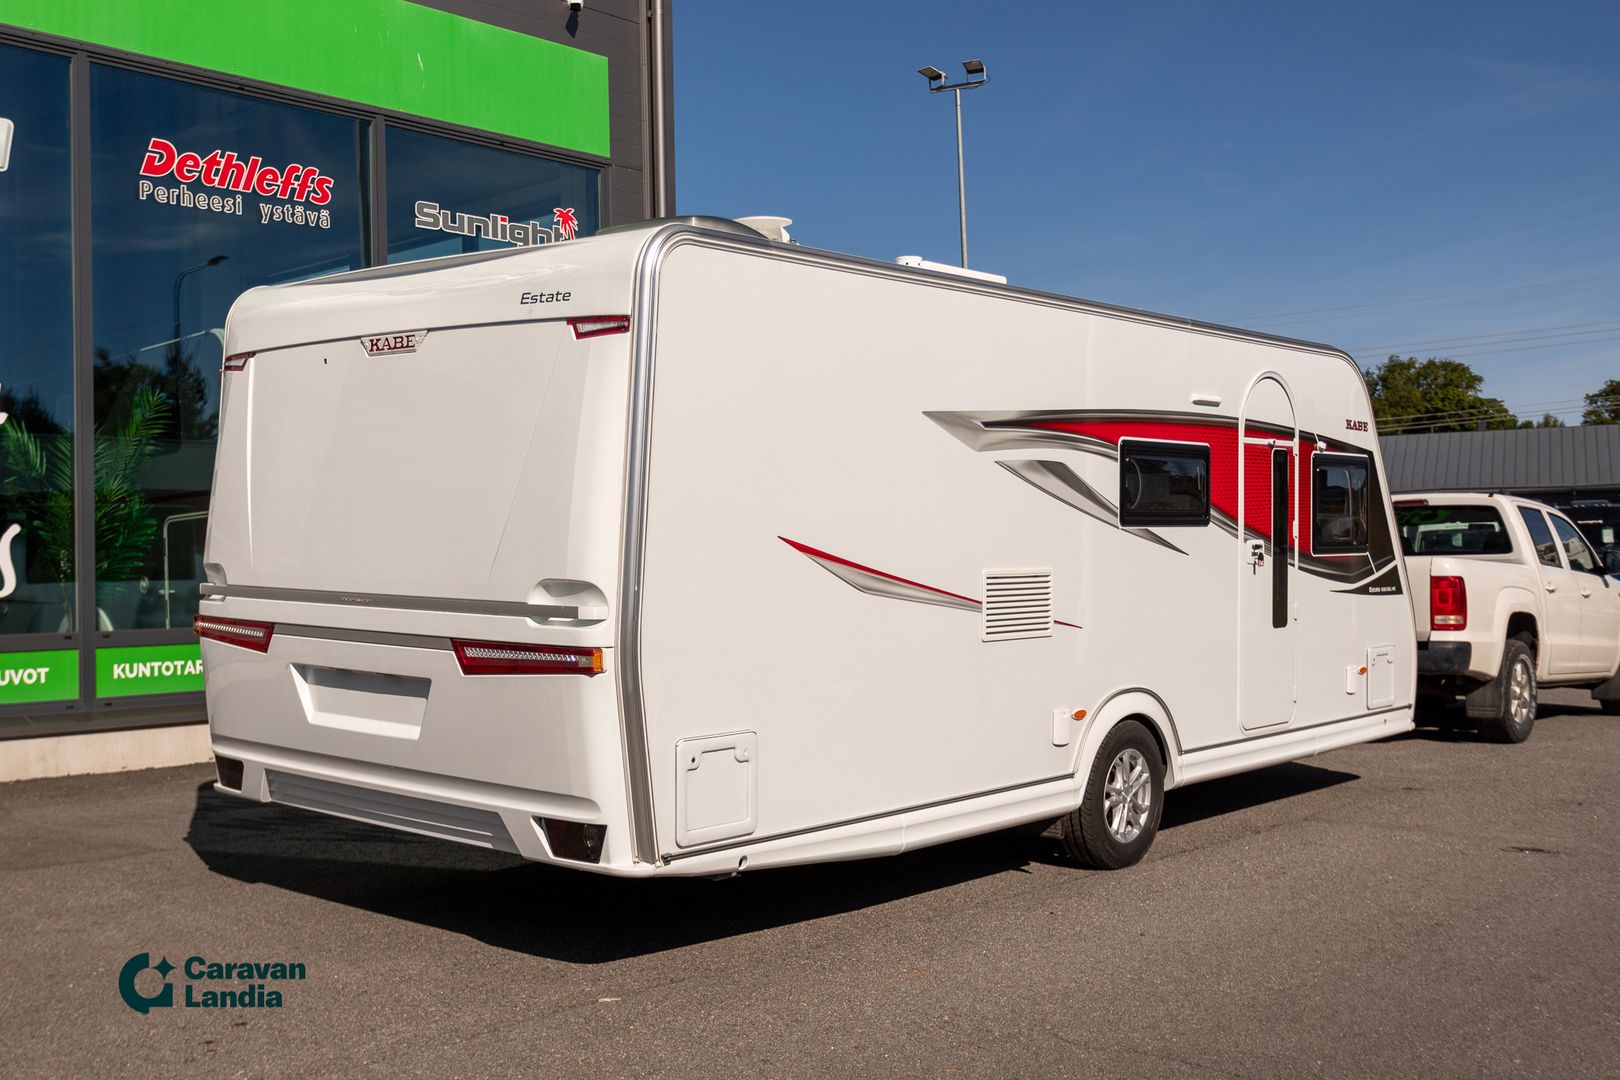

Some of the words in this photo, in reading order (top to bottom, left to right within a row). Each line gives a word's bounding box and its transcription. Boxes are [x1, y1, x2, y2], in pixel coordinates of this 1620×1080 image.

[139, 137, 335, 205] Dethleffs
[139, 180, 243, 215] Perheesi
[259, 203, 331, 229] ystävä
[520, 290, 571, 305] Estate
[369, 334, 416, 352] KABE
[1345, 418, 1368, 432] KABE
